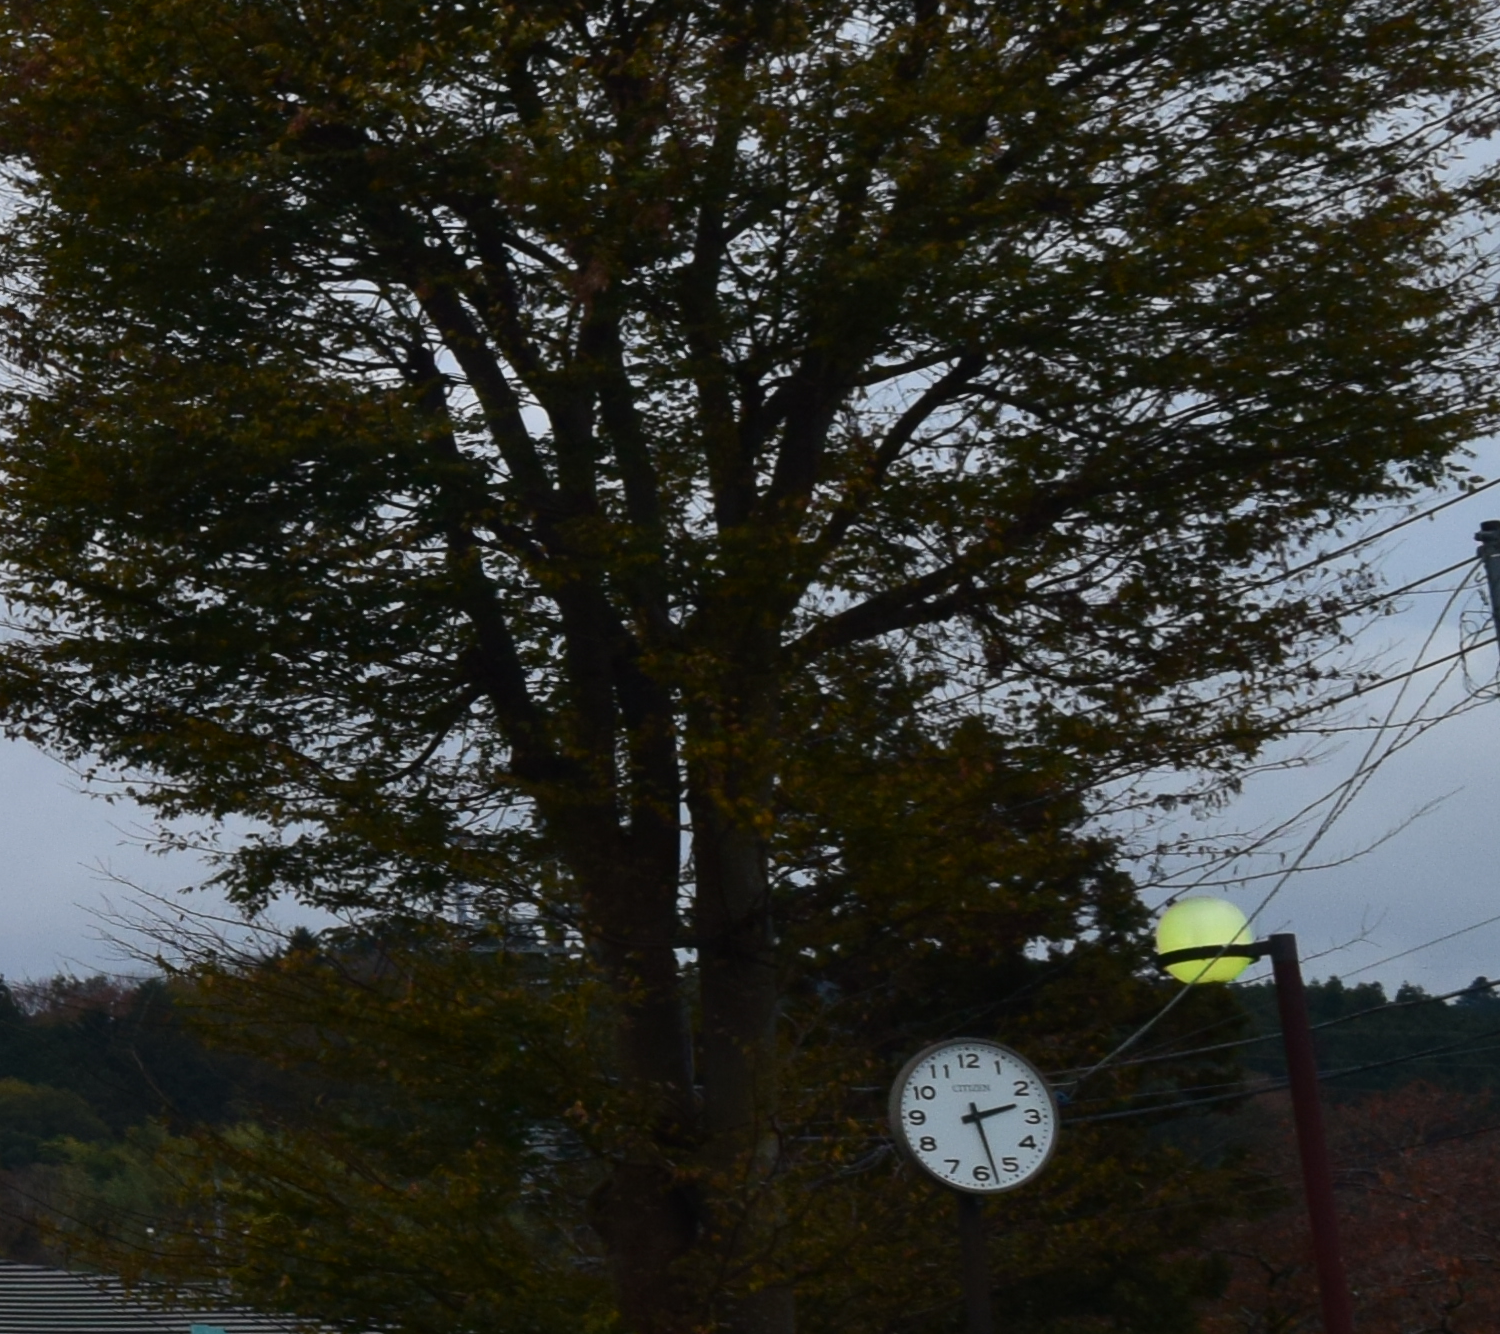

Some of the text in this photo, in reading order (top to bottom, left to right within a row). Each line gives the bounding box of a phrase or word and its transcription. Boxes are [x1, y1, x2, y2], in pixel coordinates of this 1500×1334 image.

[957, 1053, 980, 1069] 12
[993, 1060, 1002, 1075] 1
[929, 1064, 950, 1079] 11
[913, 1085, 937, 1101] 10
[951, 1084, 991, 1093] CITIZEN
[1012, 1080, 1030, 1097] 2
[908, 1109, 927, 1126] 9
[1023, 1108, 1042, 1125] 3
[919, 1136, 938, 1152] 8
[1017, 1135, 1037, 1150] 4
[943, 1159, 961, 1175] 7
[1001, 1157, 1020, 1173] 5
[972, 1165, 991, 1182] 6
